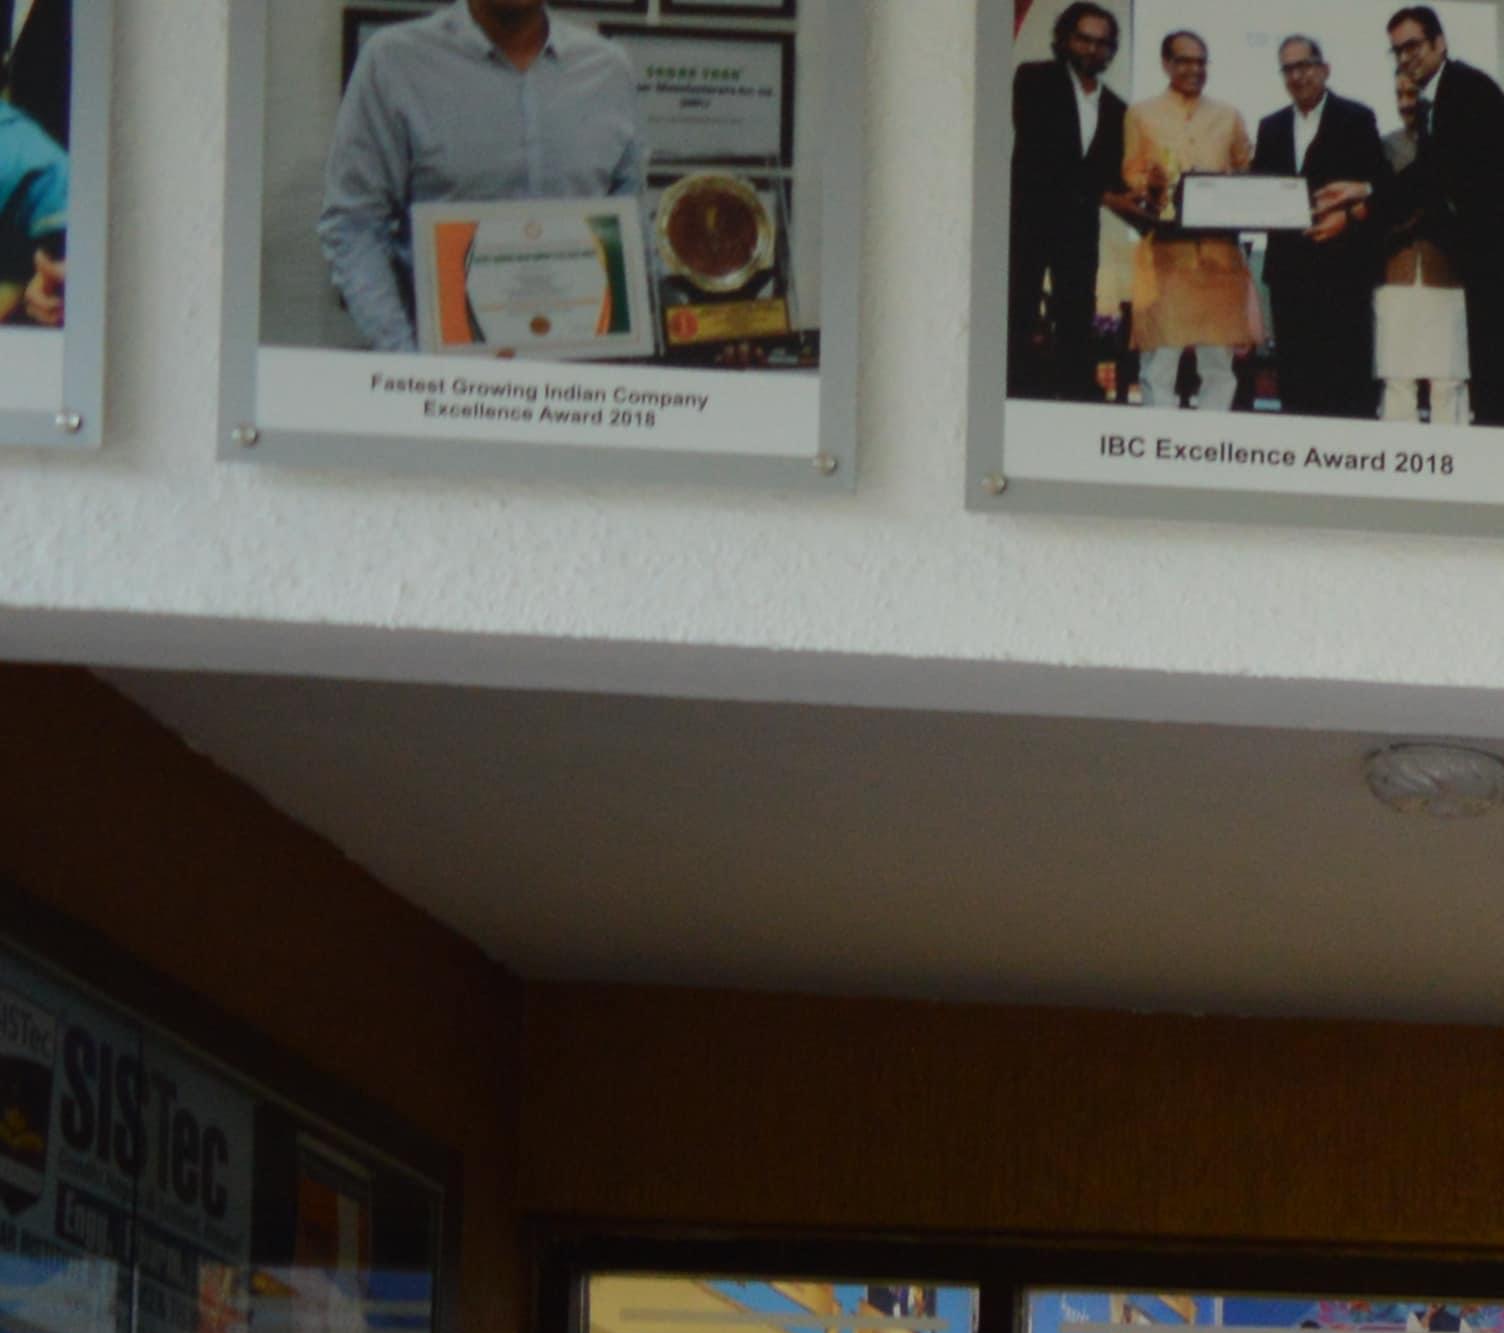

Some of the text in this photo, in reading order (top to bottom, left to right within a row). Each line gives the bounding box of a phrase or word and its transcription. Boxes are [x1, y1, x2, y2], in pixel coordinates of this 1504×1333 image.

[370, 373, 709, 411] Fastest Growing Indian Company
[423, 400, 656, 428] Excellence Award 2018
[1099, 435, 1455, 476] IBC Excellence Award 2018
[60, 1027, 229, 1220] SISTec
